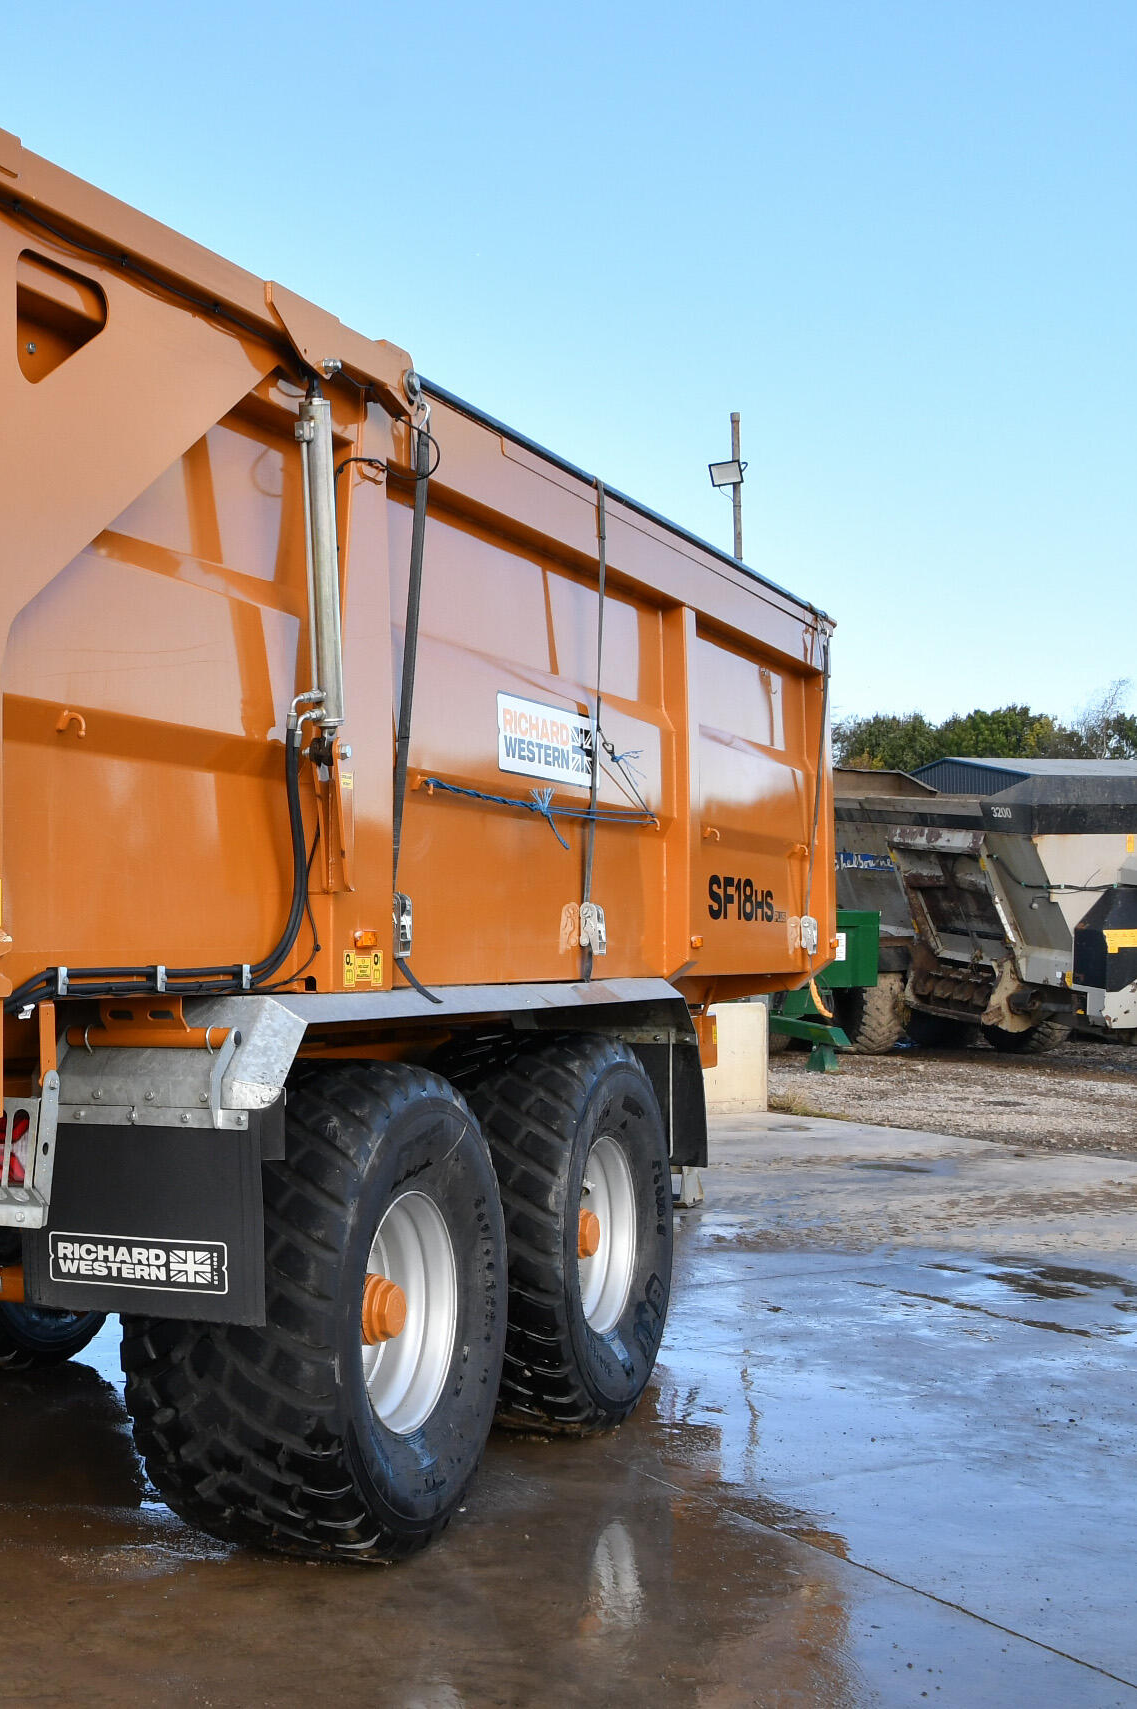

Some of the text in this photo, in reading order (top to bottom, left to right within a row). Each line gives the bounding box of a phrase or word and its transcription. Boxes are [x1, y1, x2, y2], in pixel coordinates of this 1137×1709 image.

[503, 708, 570, 746] RICHARD
[504, 735, 569, 770] WESTERN
[990, 806, 1012, 819] 3200
[57, 1241, 167, 1266] RICHARD
[58, 1258, 167, 1281] WESTERN
